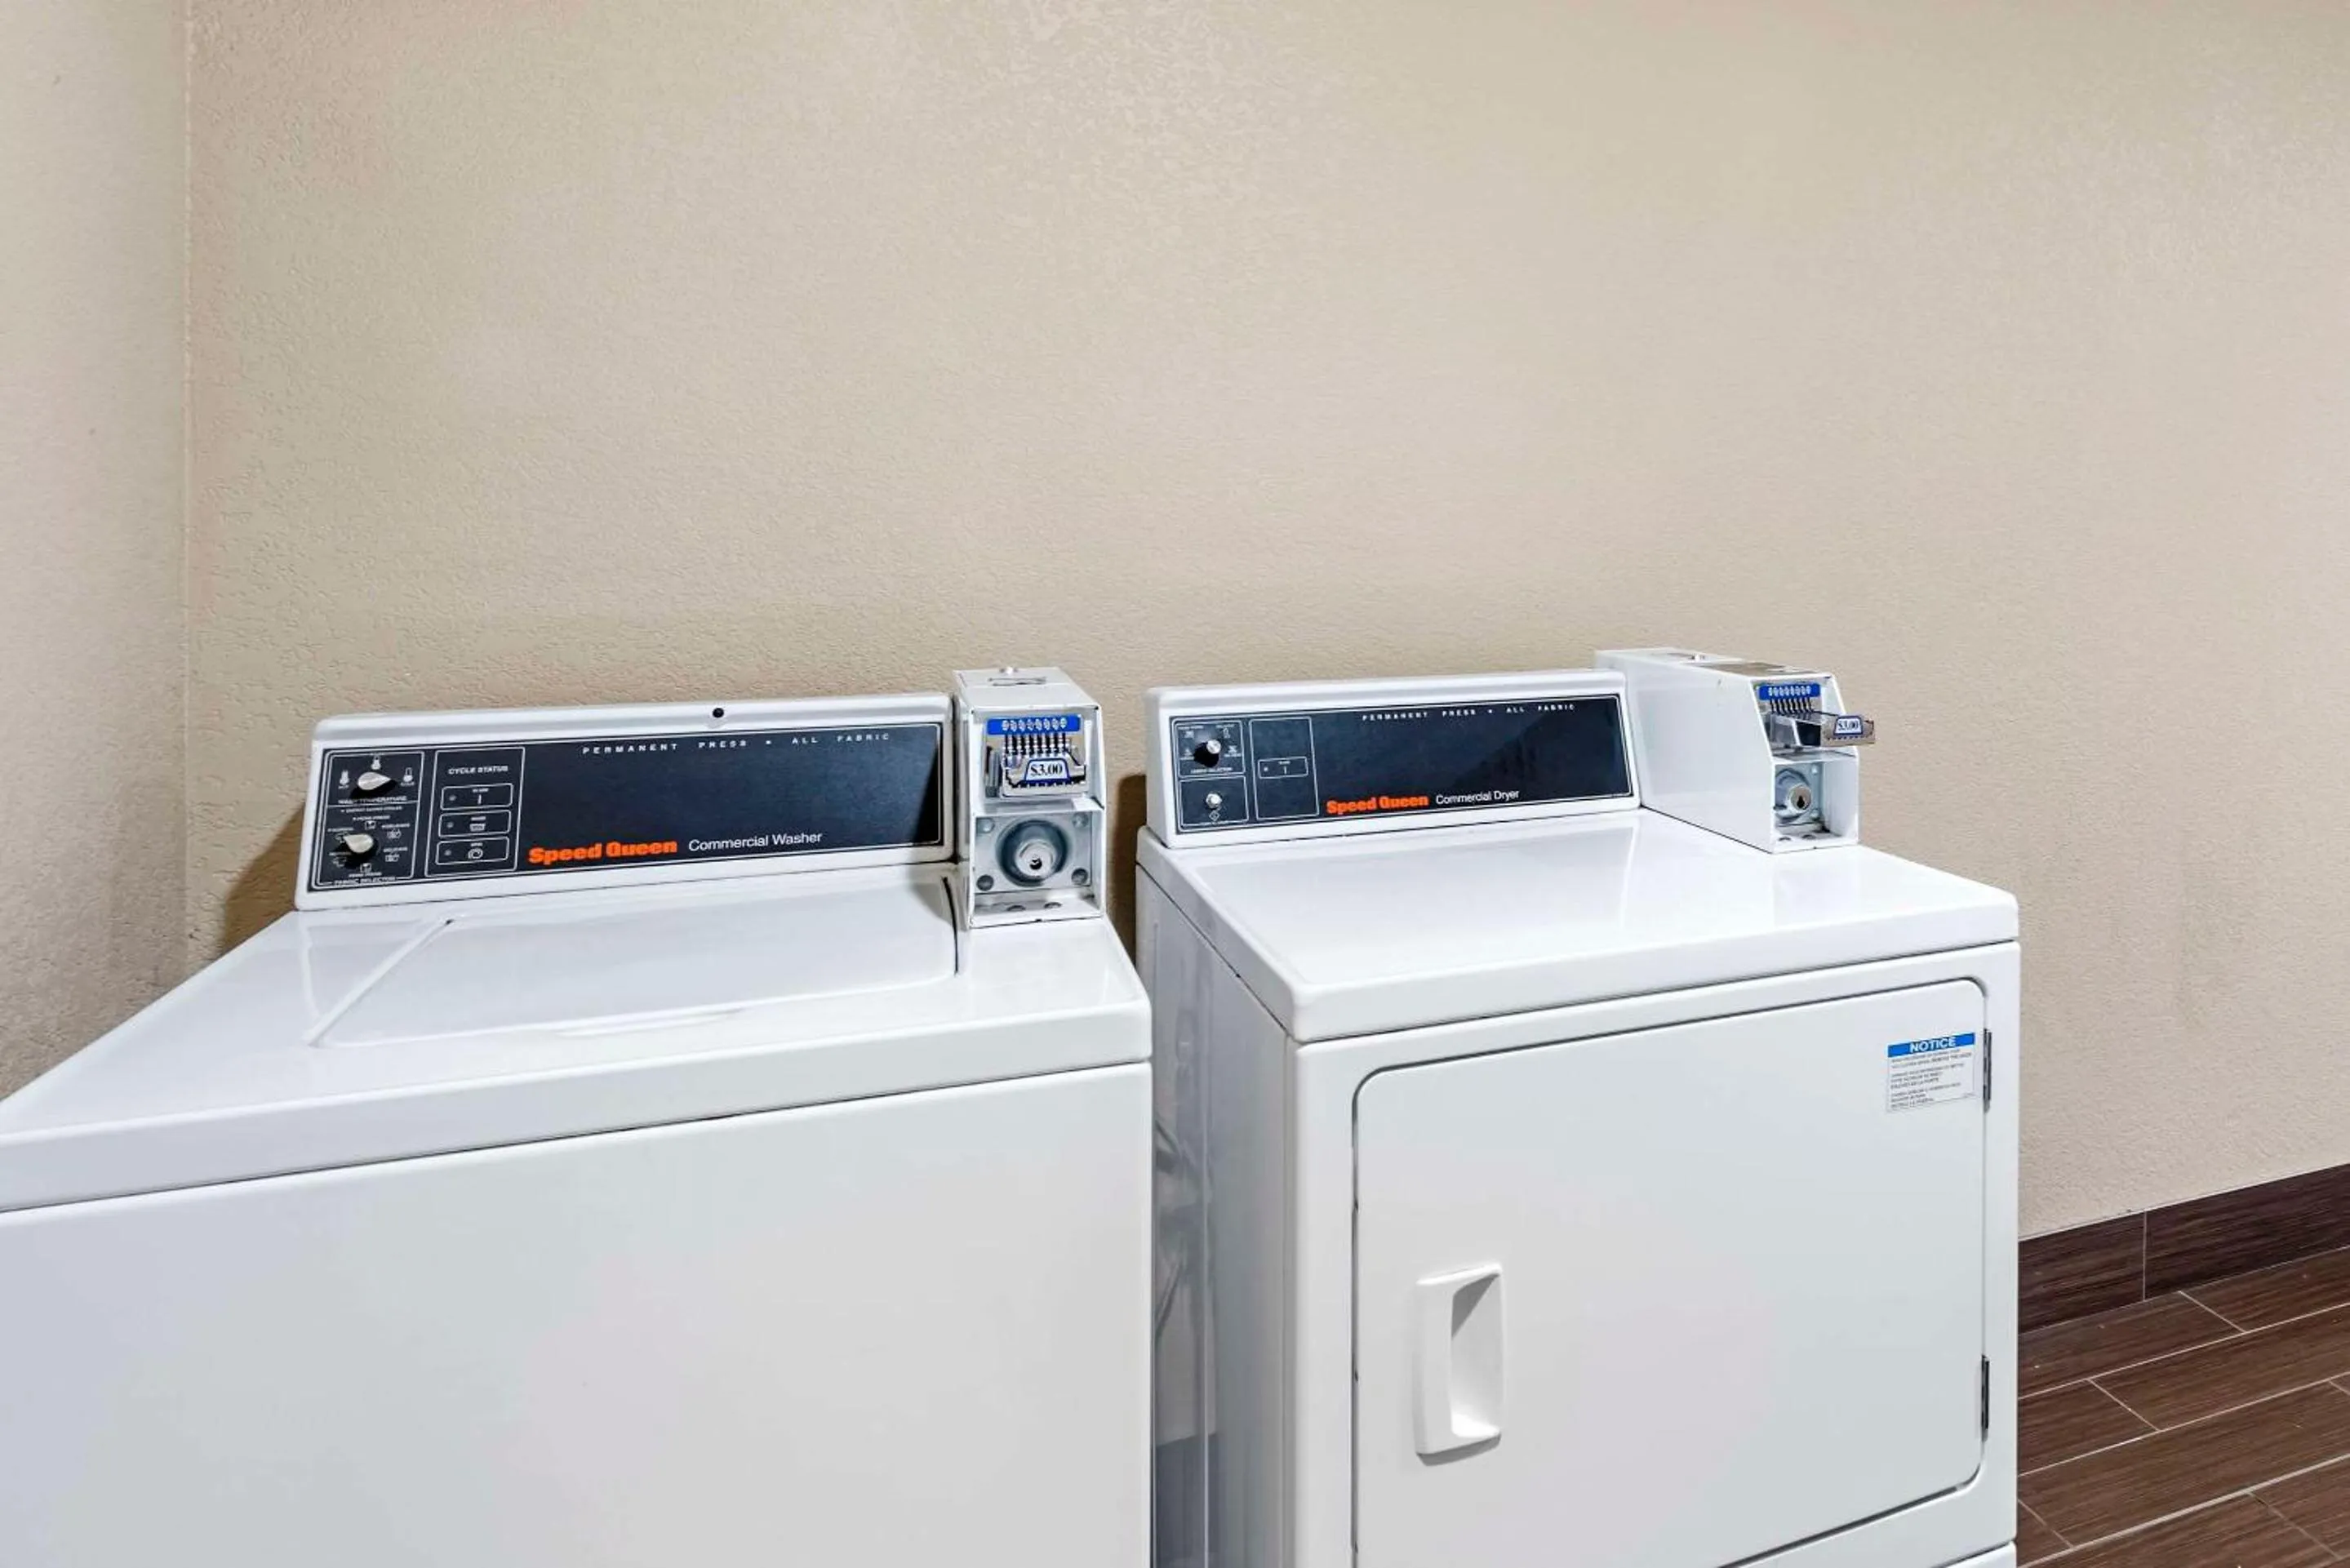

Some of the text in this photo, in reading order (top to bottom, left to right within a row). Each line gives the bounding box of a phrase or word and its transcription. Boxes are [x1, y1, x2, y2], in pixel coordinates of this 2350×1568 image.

[582, 733, 890, 755] PERMANENT PRESS ALL FABRIC
[448, 766, 475, 775] CYCLE
[1326, 795, 1429, 815] Speed Queen
[1435, 789, 1521, 805] Commercial Dryer
[688, 832, 824, 851] Commercial Washer
[529, 840, 678, 865] Speed Queen
[1910, 1036, 1957, 1054] NOTICE
